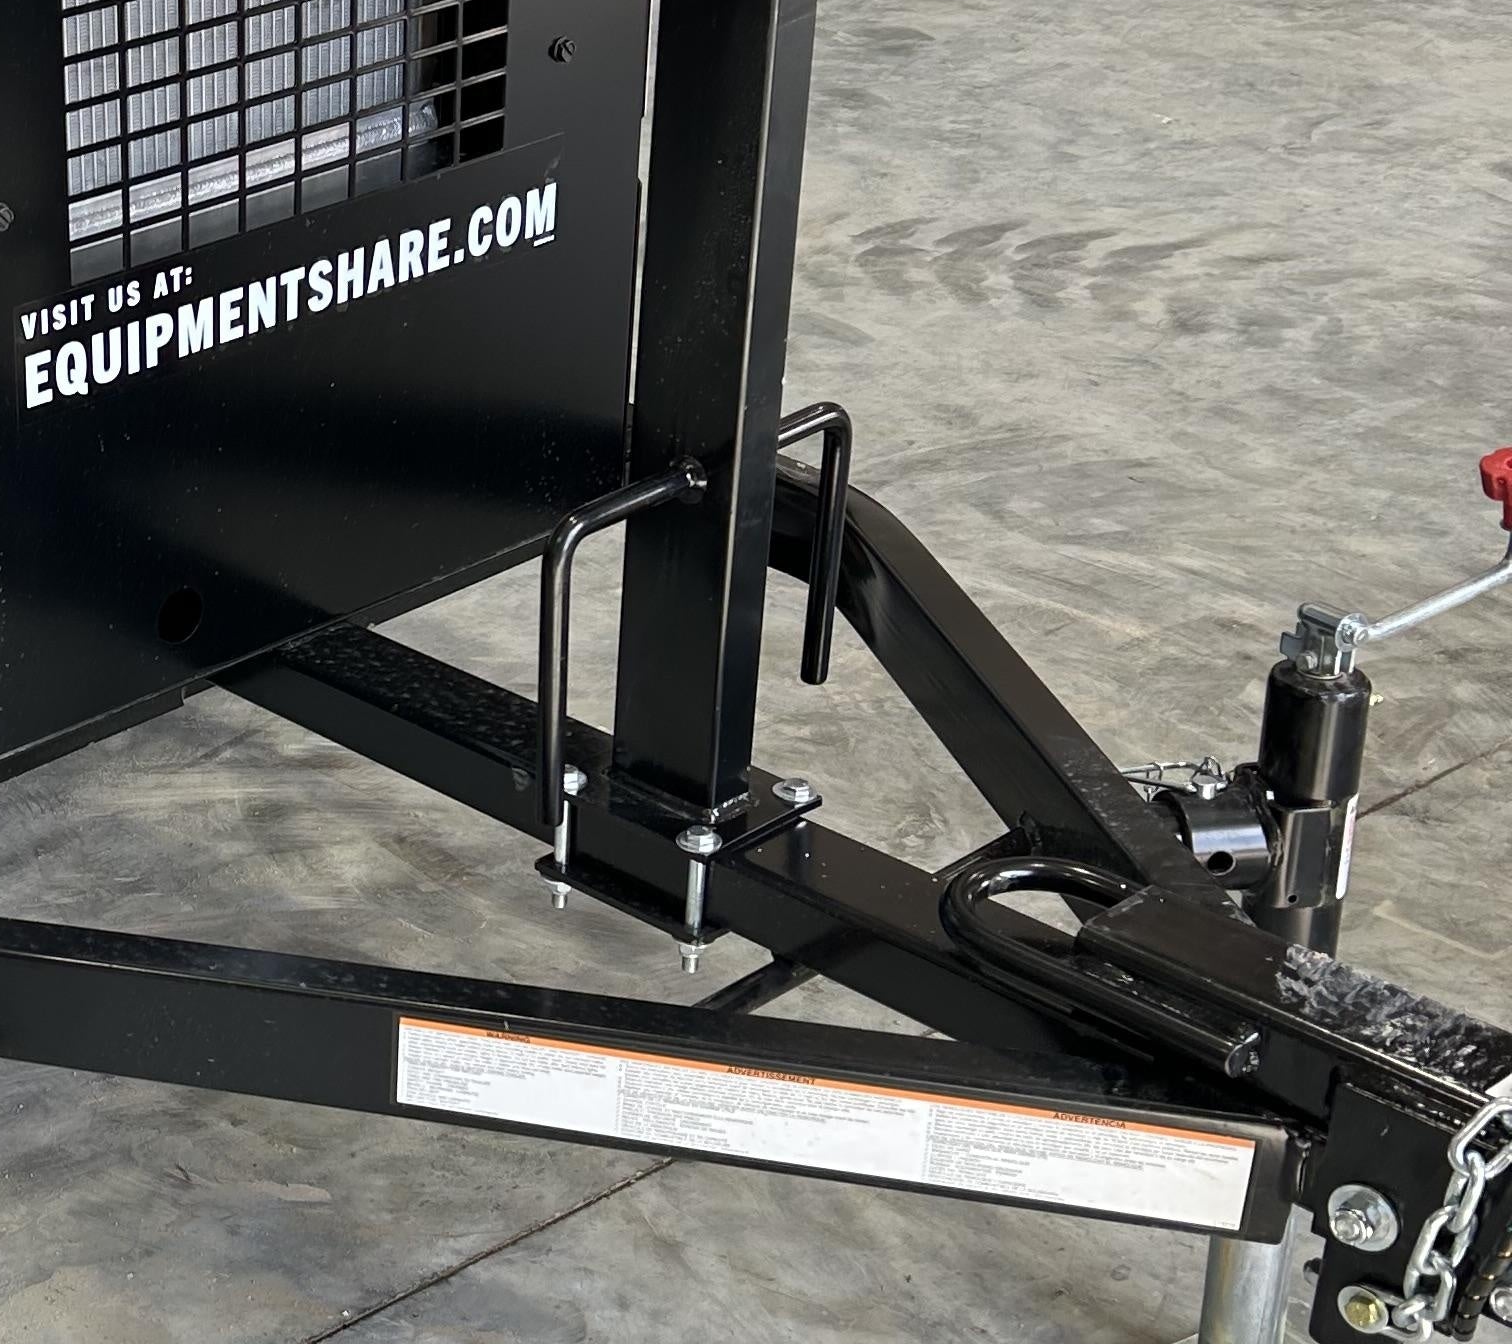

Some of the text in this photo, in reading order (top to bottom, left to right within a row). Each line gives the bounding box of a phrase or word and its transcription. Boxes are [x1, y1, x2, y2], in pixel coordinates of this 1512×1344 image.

[21, 266, 193, 340] VISIT US AT:
[24, 183, 558, 409] EQUIPMENTSHARE.COM
[1052, 1110, 1128, 1129] ADVERTENCIA
